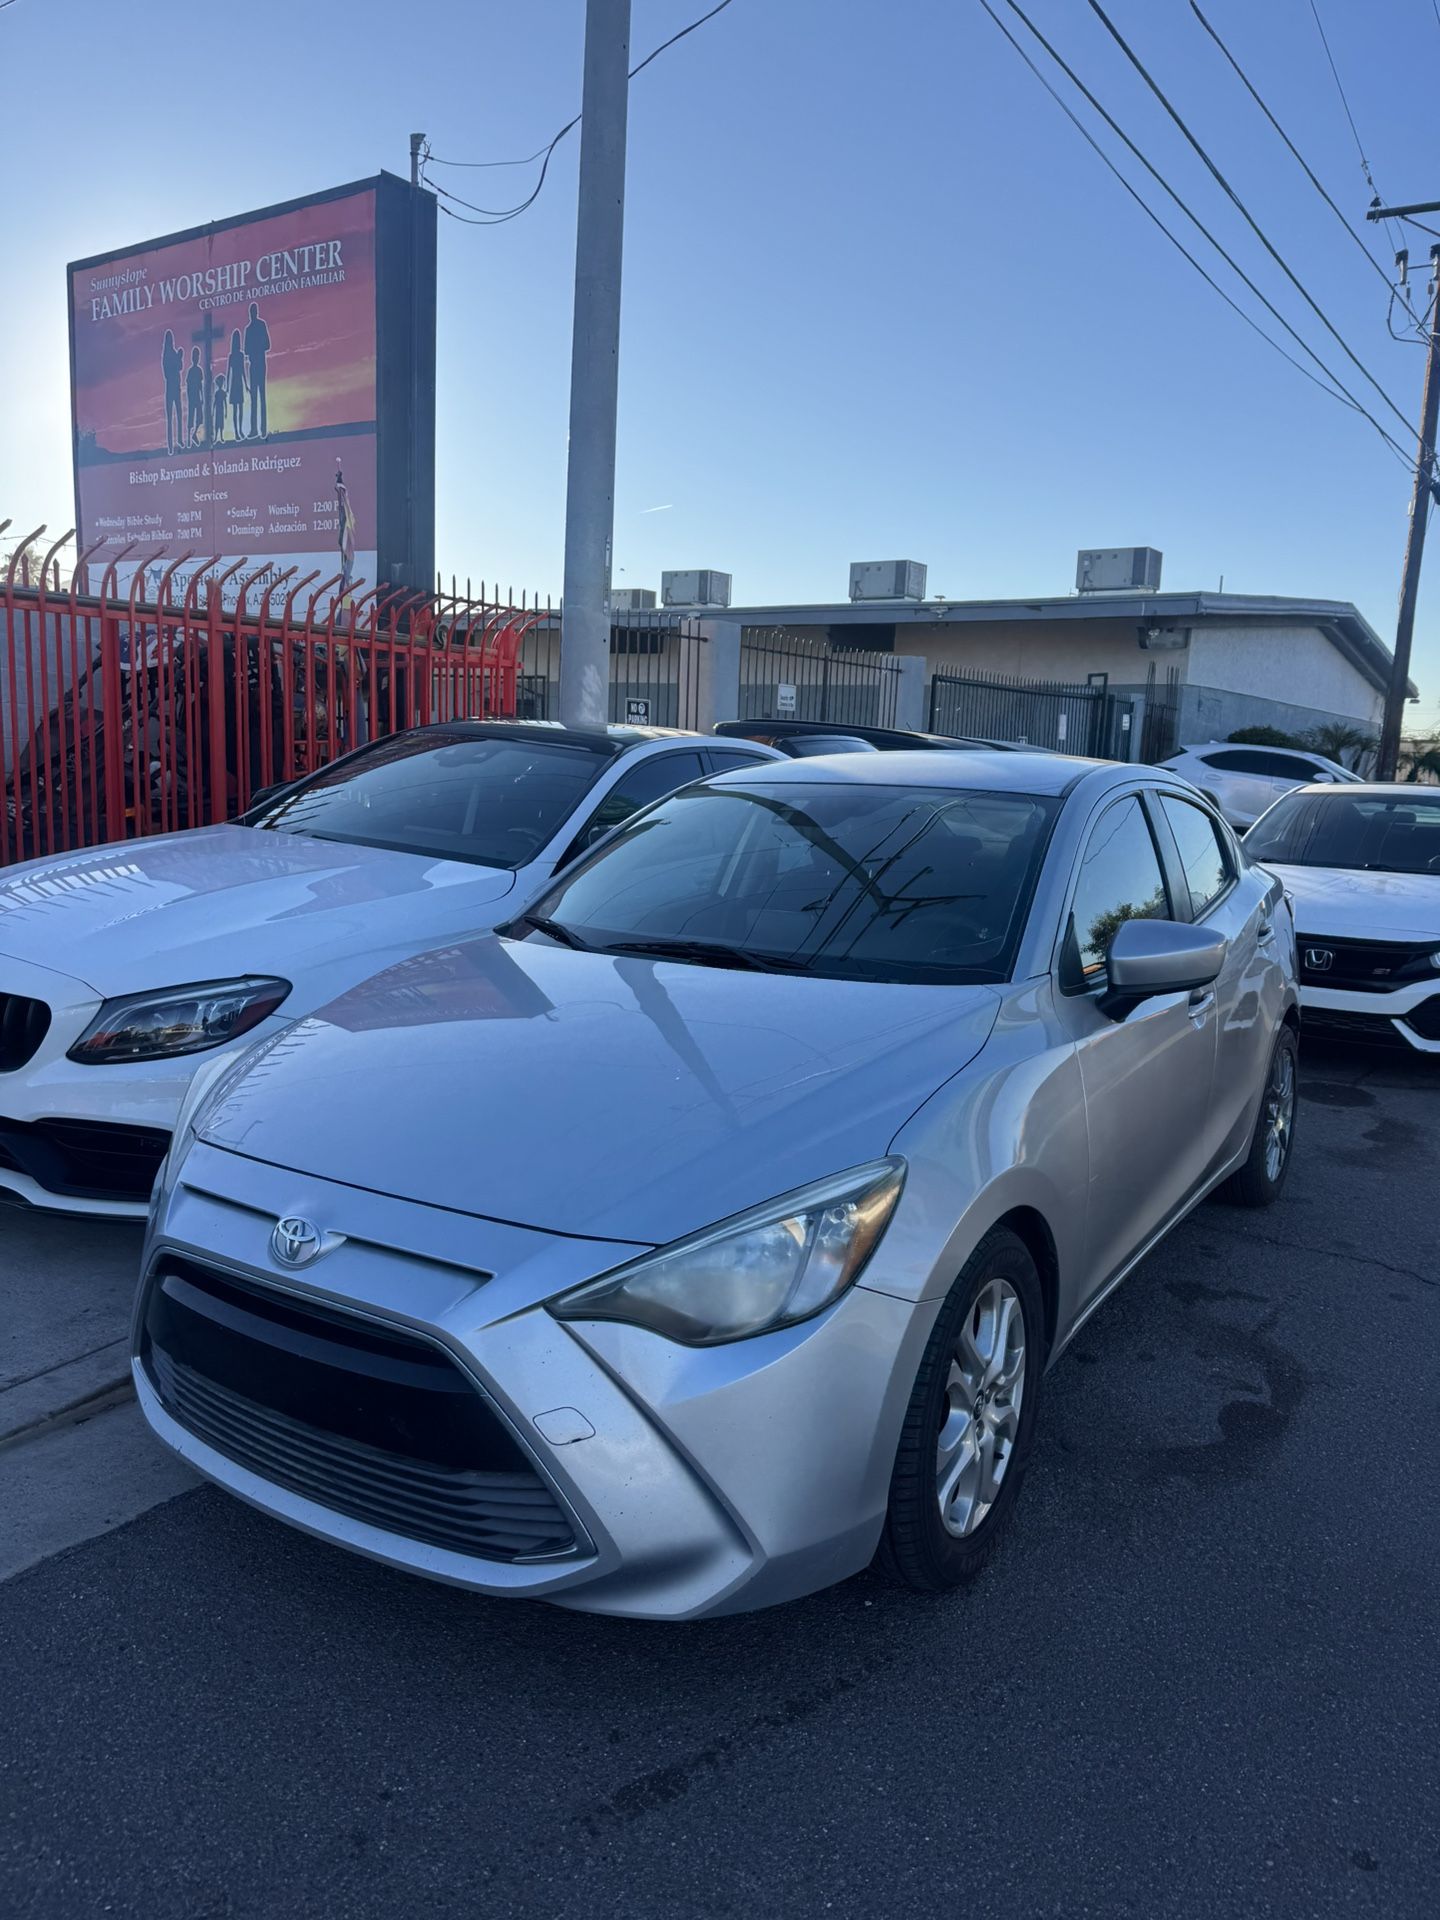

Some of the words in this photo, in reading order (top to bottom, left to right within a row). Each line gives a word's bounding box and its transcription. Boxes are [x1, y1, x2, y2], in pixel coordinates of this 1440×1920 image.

[90, 268, 148, 292] Sunnyslope
[91, 283, 156, 321] FAMILY
[160, 260, 251, 305] WORSHIP
[256, 240, 344, 282] CENTER
[199, 292, 232, 310] CENTRO
[233, 290, 245, 302] DE
[246, 277, 299, 300] ADORACIÓN
[300, 270, 346, 289] FAMILIAR
[129, 471, 159, 486] Bishop
[160, 464, 199, 484] Raymond
[202, 463, 210, 476] &
[212, 459, 249, 475] Yolanda
[251, 455, 301, 472] Rodríguez
[193, 490, 228, 502] Services
[126, 515, 143, 526] Bible
[144, 514, 162, 527] Study
[177, 512, 190, 523] 7:00
[190, 510, 202, 521] PM
[231, 506, 257, 519] Sunday
[268, 503, 300, 517] Worship
[313, 501, 332, 512] 12:00
[177, 529, 190, 539] 7:00
[190, 528, 202, 538] PM
[231, 524, 264, 537] Domingo
[268, 520, 307, 533] Adoración
[313, 520, 332, 531] 12:00
